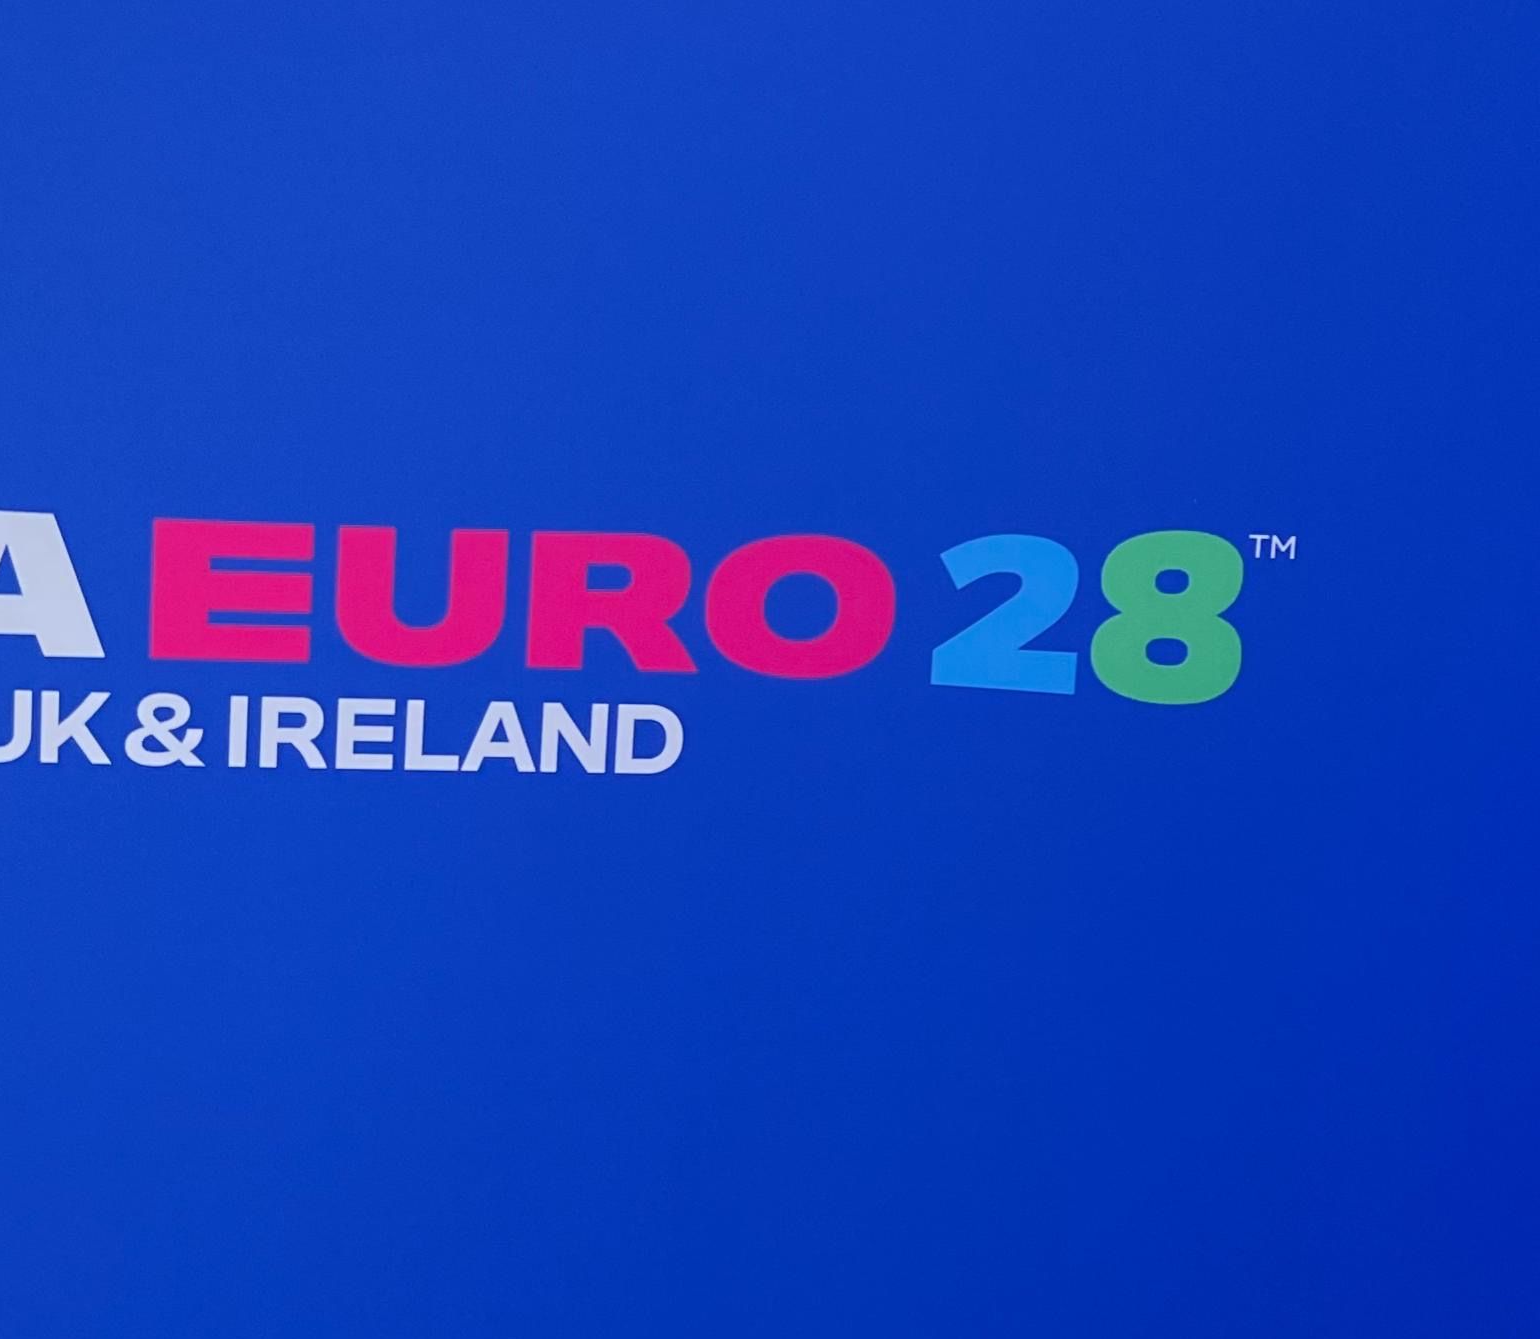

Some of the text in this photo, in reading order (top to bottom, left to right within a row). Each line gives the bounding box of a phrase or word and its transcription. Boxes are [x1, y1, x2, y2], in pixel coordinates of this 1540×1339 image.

[149, 517, 896, 680] EURO
[930, 530, 1244, 705] 28
[124, 692, 205, 768] &
[227, 695, 684, 774] IRELAND
